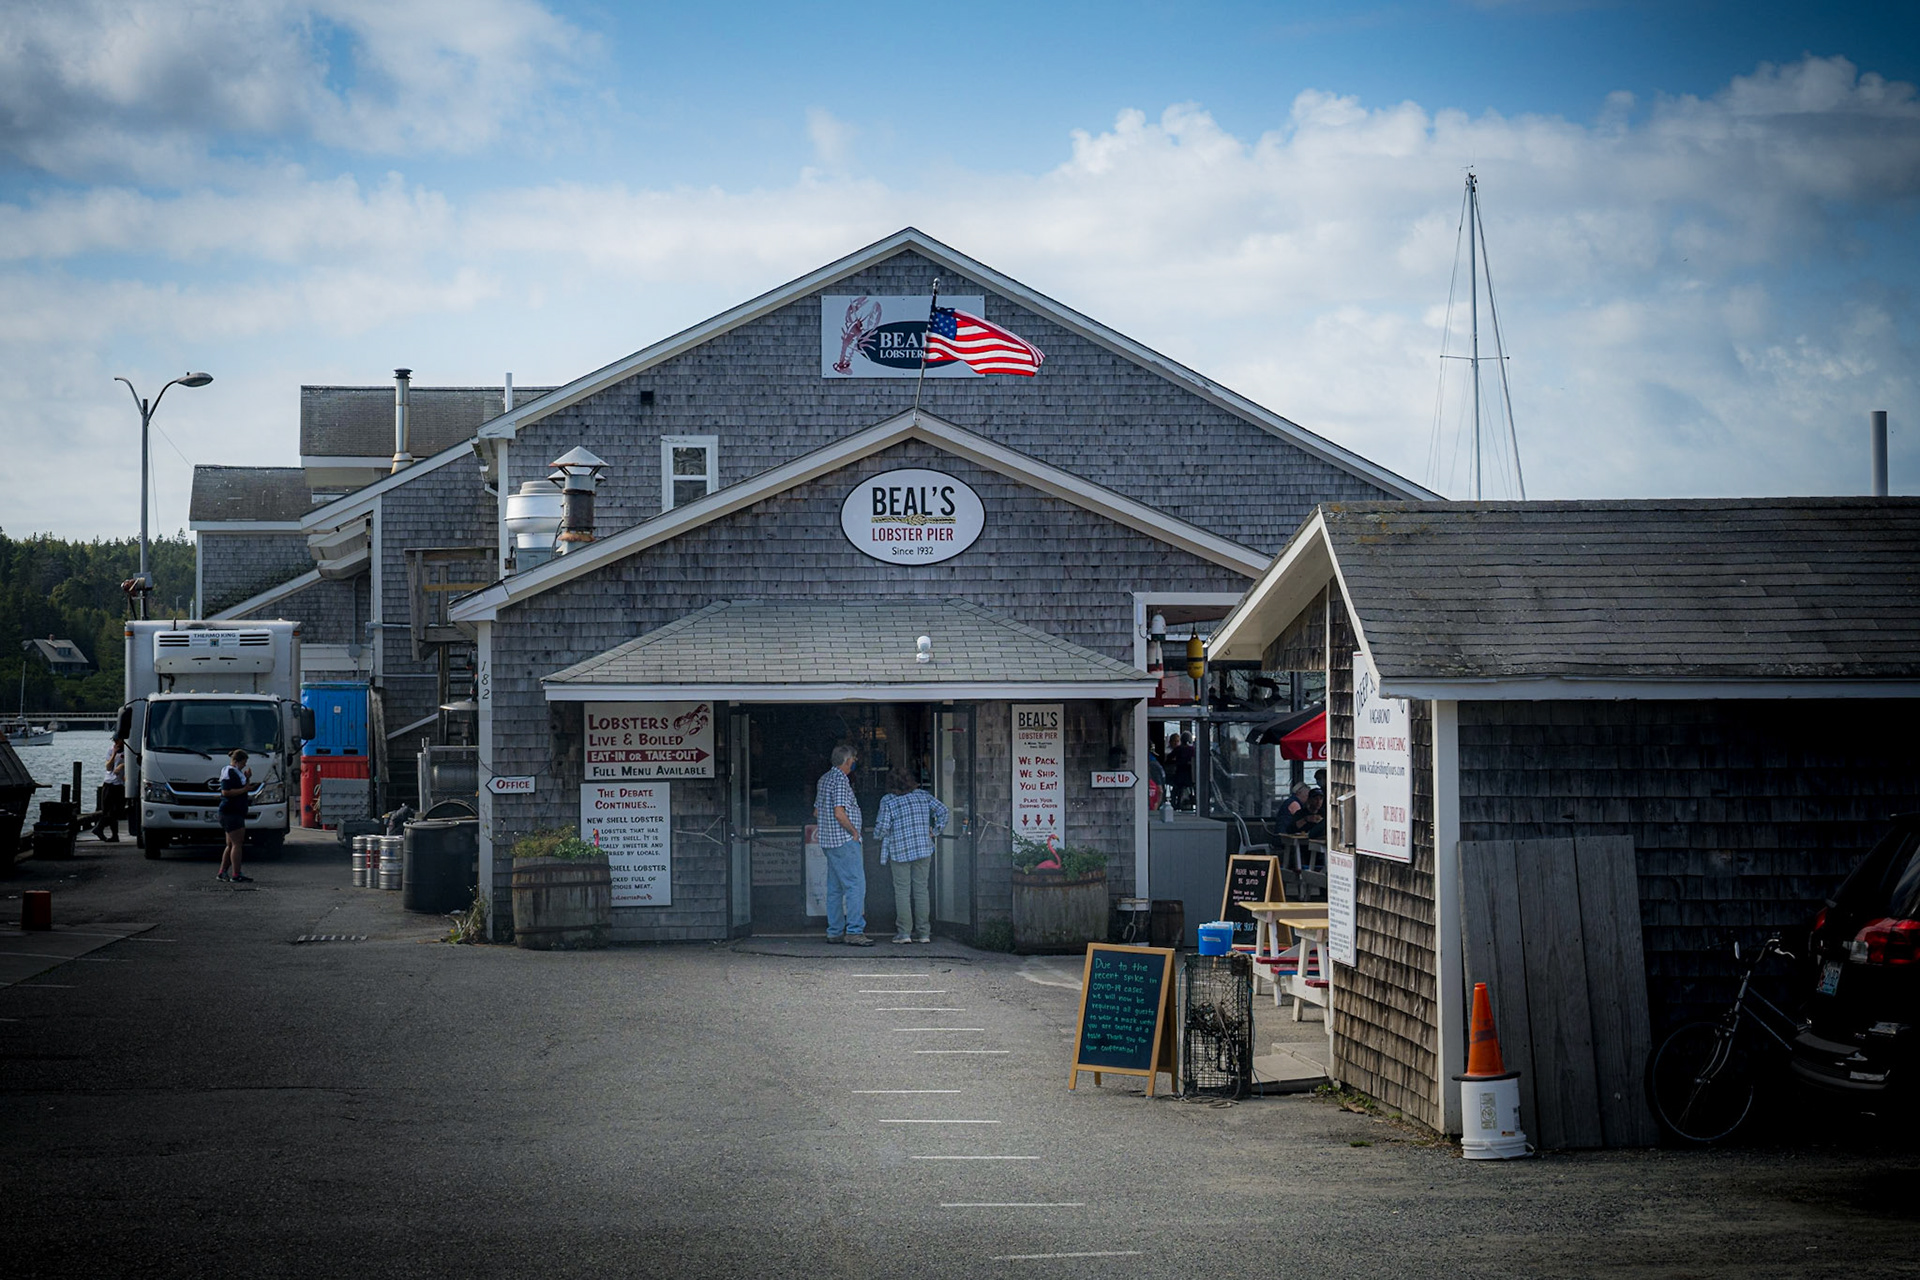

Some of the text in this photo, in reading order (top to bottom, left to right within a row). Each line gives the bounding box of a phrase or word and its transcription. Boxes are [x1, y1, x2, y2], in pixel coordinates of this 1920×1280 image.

[880, 350, 923, 358] LOBSTER
[872, 486, 955, 516] BEAL'S
[872, 527, 954, 541] LOBSTER PIER
[892, 546, 934, 555] Since 1932
[481, 661, 490, 700] 182
[588, 714, 669, 730] LOBSTERS
[1018, 712, 1058, 727] BEAL'S
[588, 733, 684, 747] LIVE & BOILED
[1018, 732, 1058, 740] LOBSTER PIER
[591, 751, 626, 762] EAT-IN
[645, 750, 698, 761] TAKE-OUT
[1018, 756, 1058, 765] WE PACK.
[593, 765, 707, 777] FULL MENU AVAILABLE
[1019, 769, 1058, 778] WE SHIP.
[1096, 774, 1130, 783] PICK UP
[496, 779, 530, 789] OFFICE
[1019, 781, 1058, 791] YOU EAT!
[597, 788, 653, 797] THE DEBATE
[595, 800, 656, 810] CONTINUES...
[1095, 958, 1148, 971] Due to the
[1094, 972, 1119, 980] recent
[1123, 974, 1144, 982] spike
[1092, 983, 1121, 992] COVID-19
[1136, 996, 1145, 1004] be
[1091, 1003, 1120, 1013] requiring
[1134, 1008, 1154, 1016] guests
